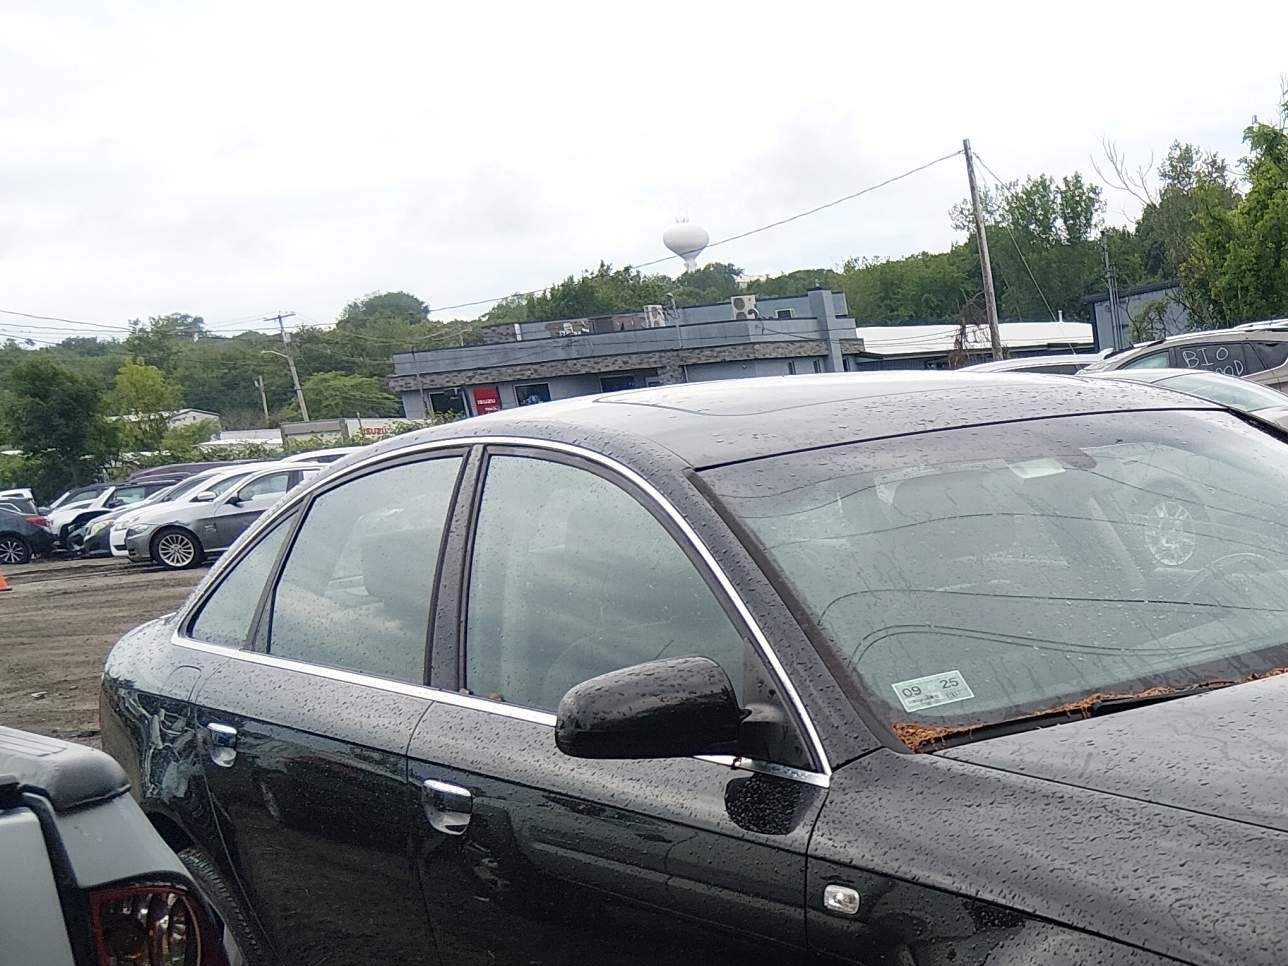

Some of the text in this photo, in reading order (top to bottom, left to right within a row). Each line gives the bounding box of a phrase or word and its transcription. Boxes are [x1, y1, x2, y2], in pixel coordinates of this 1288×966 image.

[1182, 347, 1229, 368] BIO
[902, 678, 959, 698] 09 25
